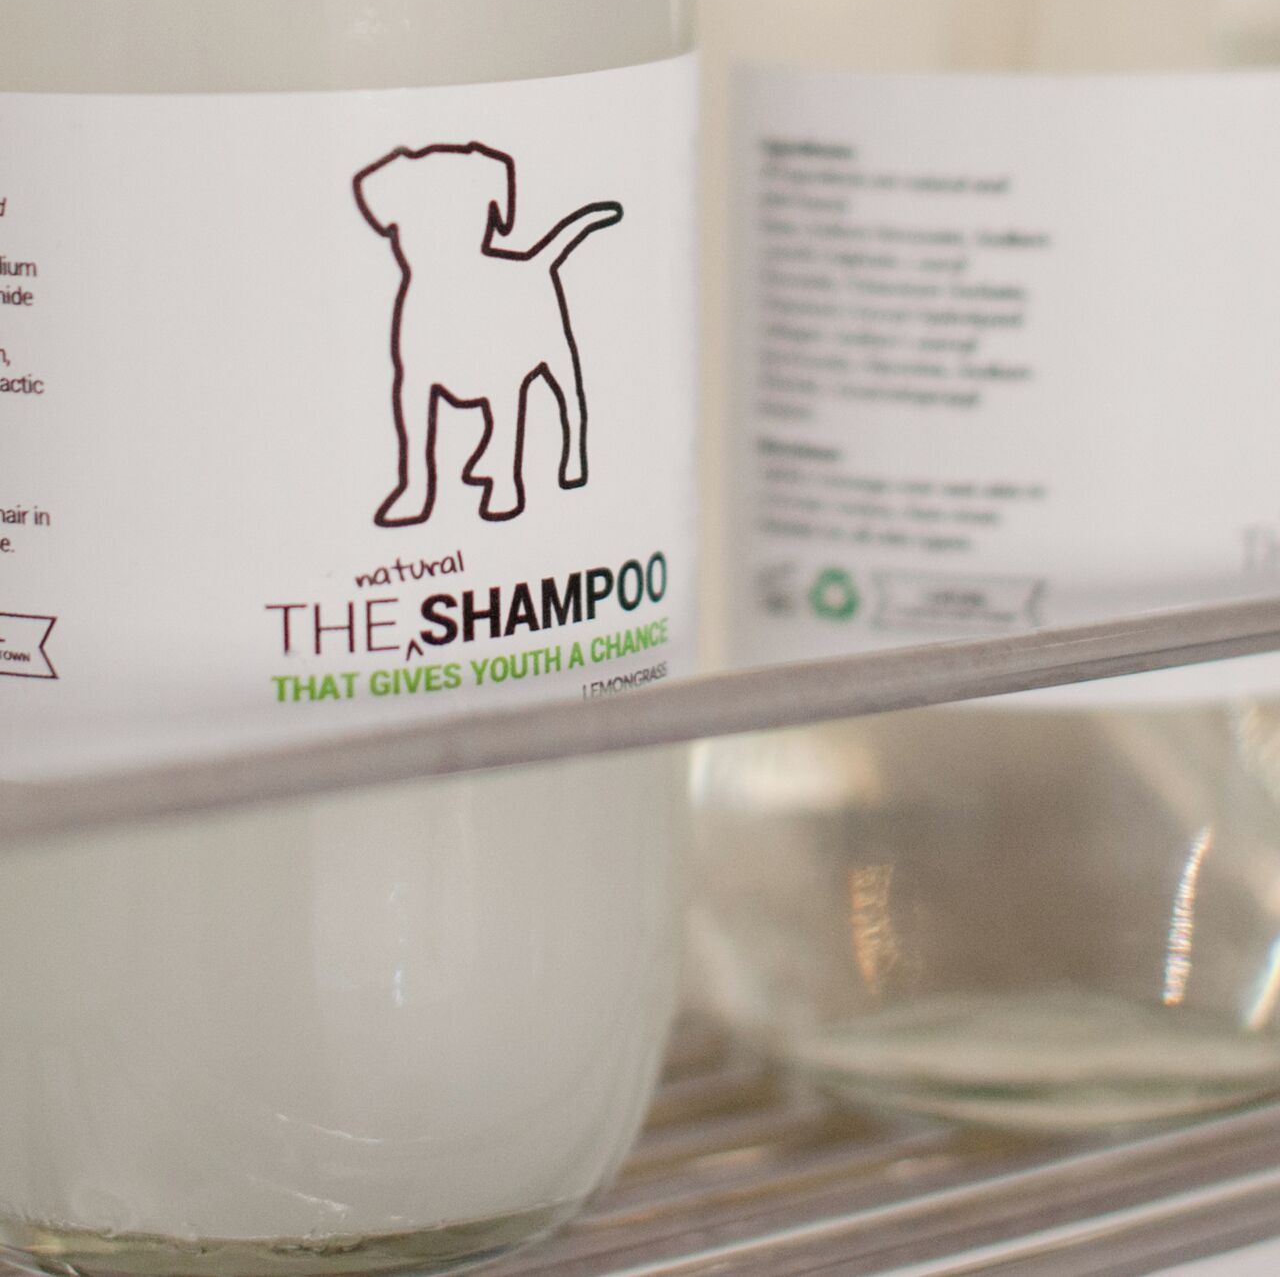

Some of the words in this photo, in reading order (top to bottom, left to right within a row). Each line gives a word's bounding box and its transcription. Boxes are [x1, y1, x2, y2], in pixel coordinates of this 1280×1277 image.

[34, 507, 51, 526] in
[355, 549, 465, 589] natural
[265, 597, 401, 656] THE
[420, 550, 668, 647] SHAMPOO
[271, 672, 360, 703] THAT
[369, 663, 462, 697] GIVES
[469, 646, 562, 686] YOUTH
[568, 645, 586, 670] A
[590, 617, 669, 664] CHANCE
[582, 661, 668, 701] LEMONGRASS
